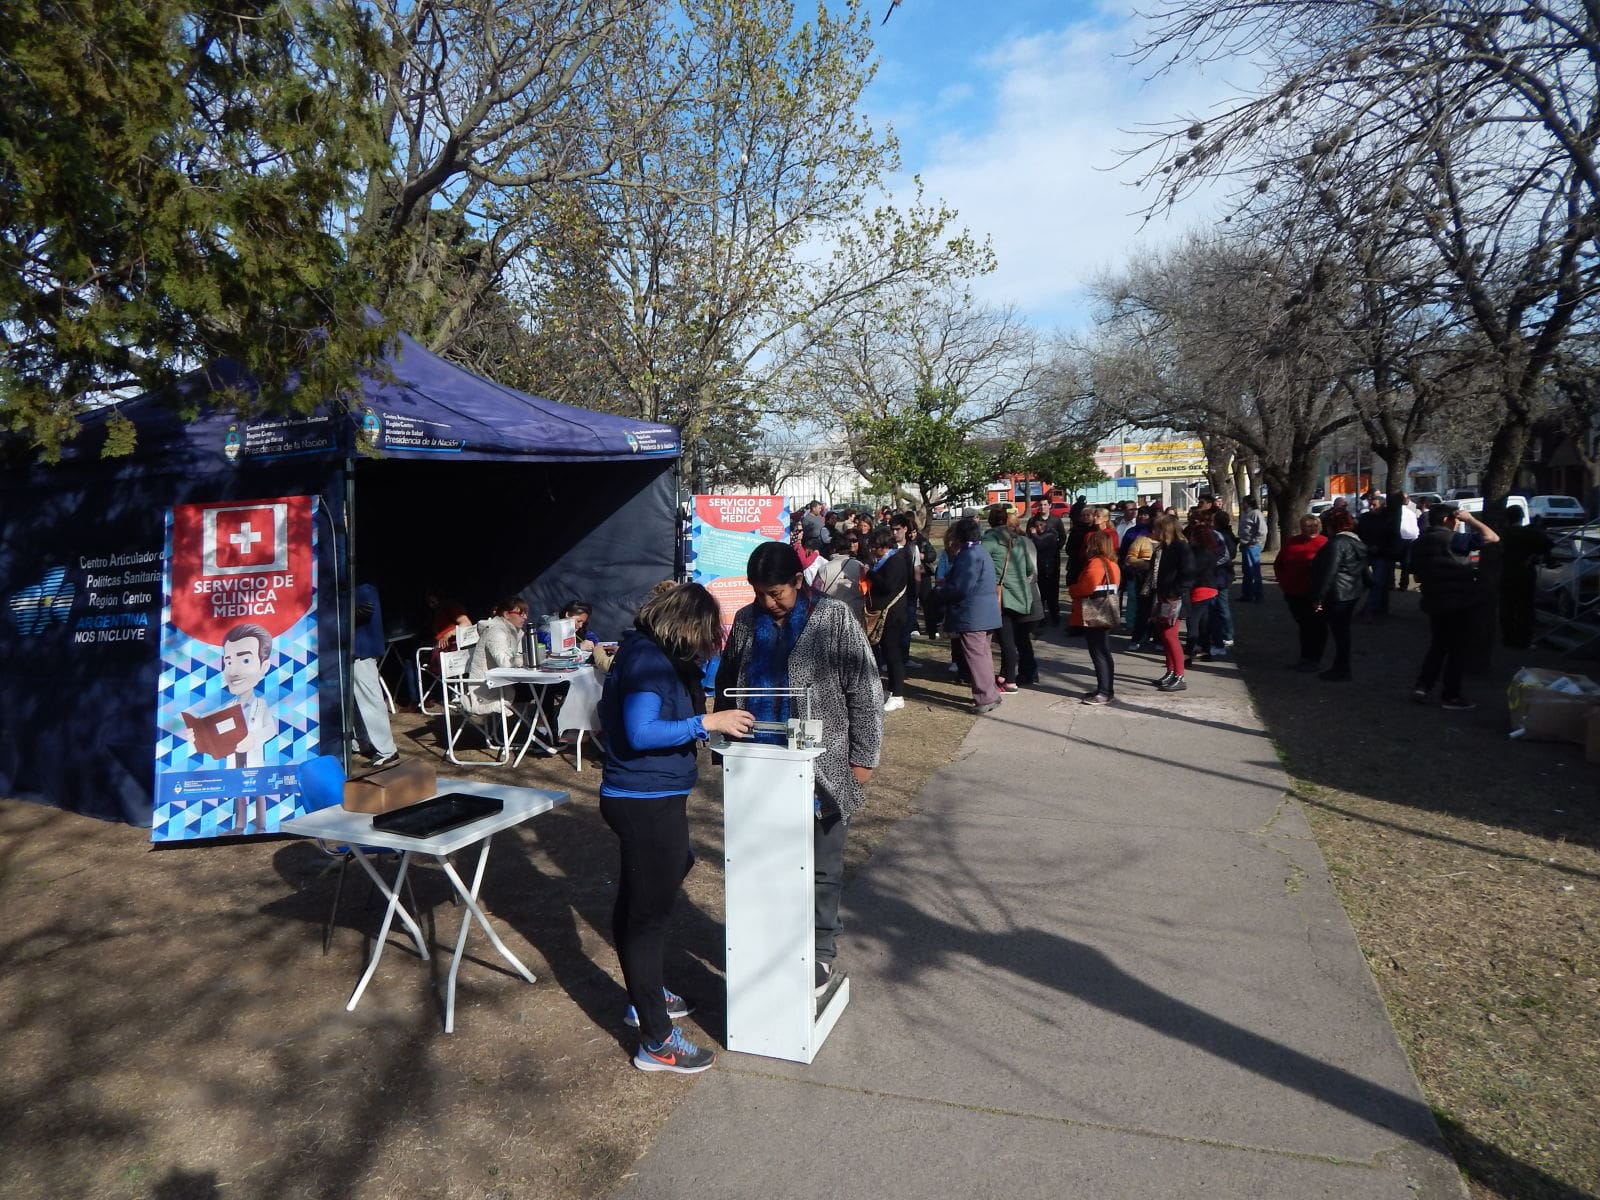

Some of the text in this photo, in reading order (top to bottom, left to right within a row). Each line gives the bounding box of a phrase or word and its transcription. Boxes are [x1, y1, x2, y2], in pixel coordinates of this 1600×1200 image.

[386, 436, 420, 444] Presidencia
[244, 444, 282, 455] Presidencia
[284, 443, 292, 451] de
[708, 498, 772, 507] SERVICIO DE
[720, 506, 762, 514] CLINICA
[722, 514, 760, 522] MEDICA
[80, 556, 108, 569] Centro
[109, 551, 158, 567] Articulador
[124, 570, 162, 584] Sanitaria
[194, 574, 294, 594] SERVICIO DE
[88, 591, 152, 609] Región Centro
[211, 589, 277, 605] CLINICA
[213, 602, 276, 618] MEDICA
[76, 612, 148, 628] ARGENTINA
[74, 628, 146, 643] NOS INCLUYE
